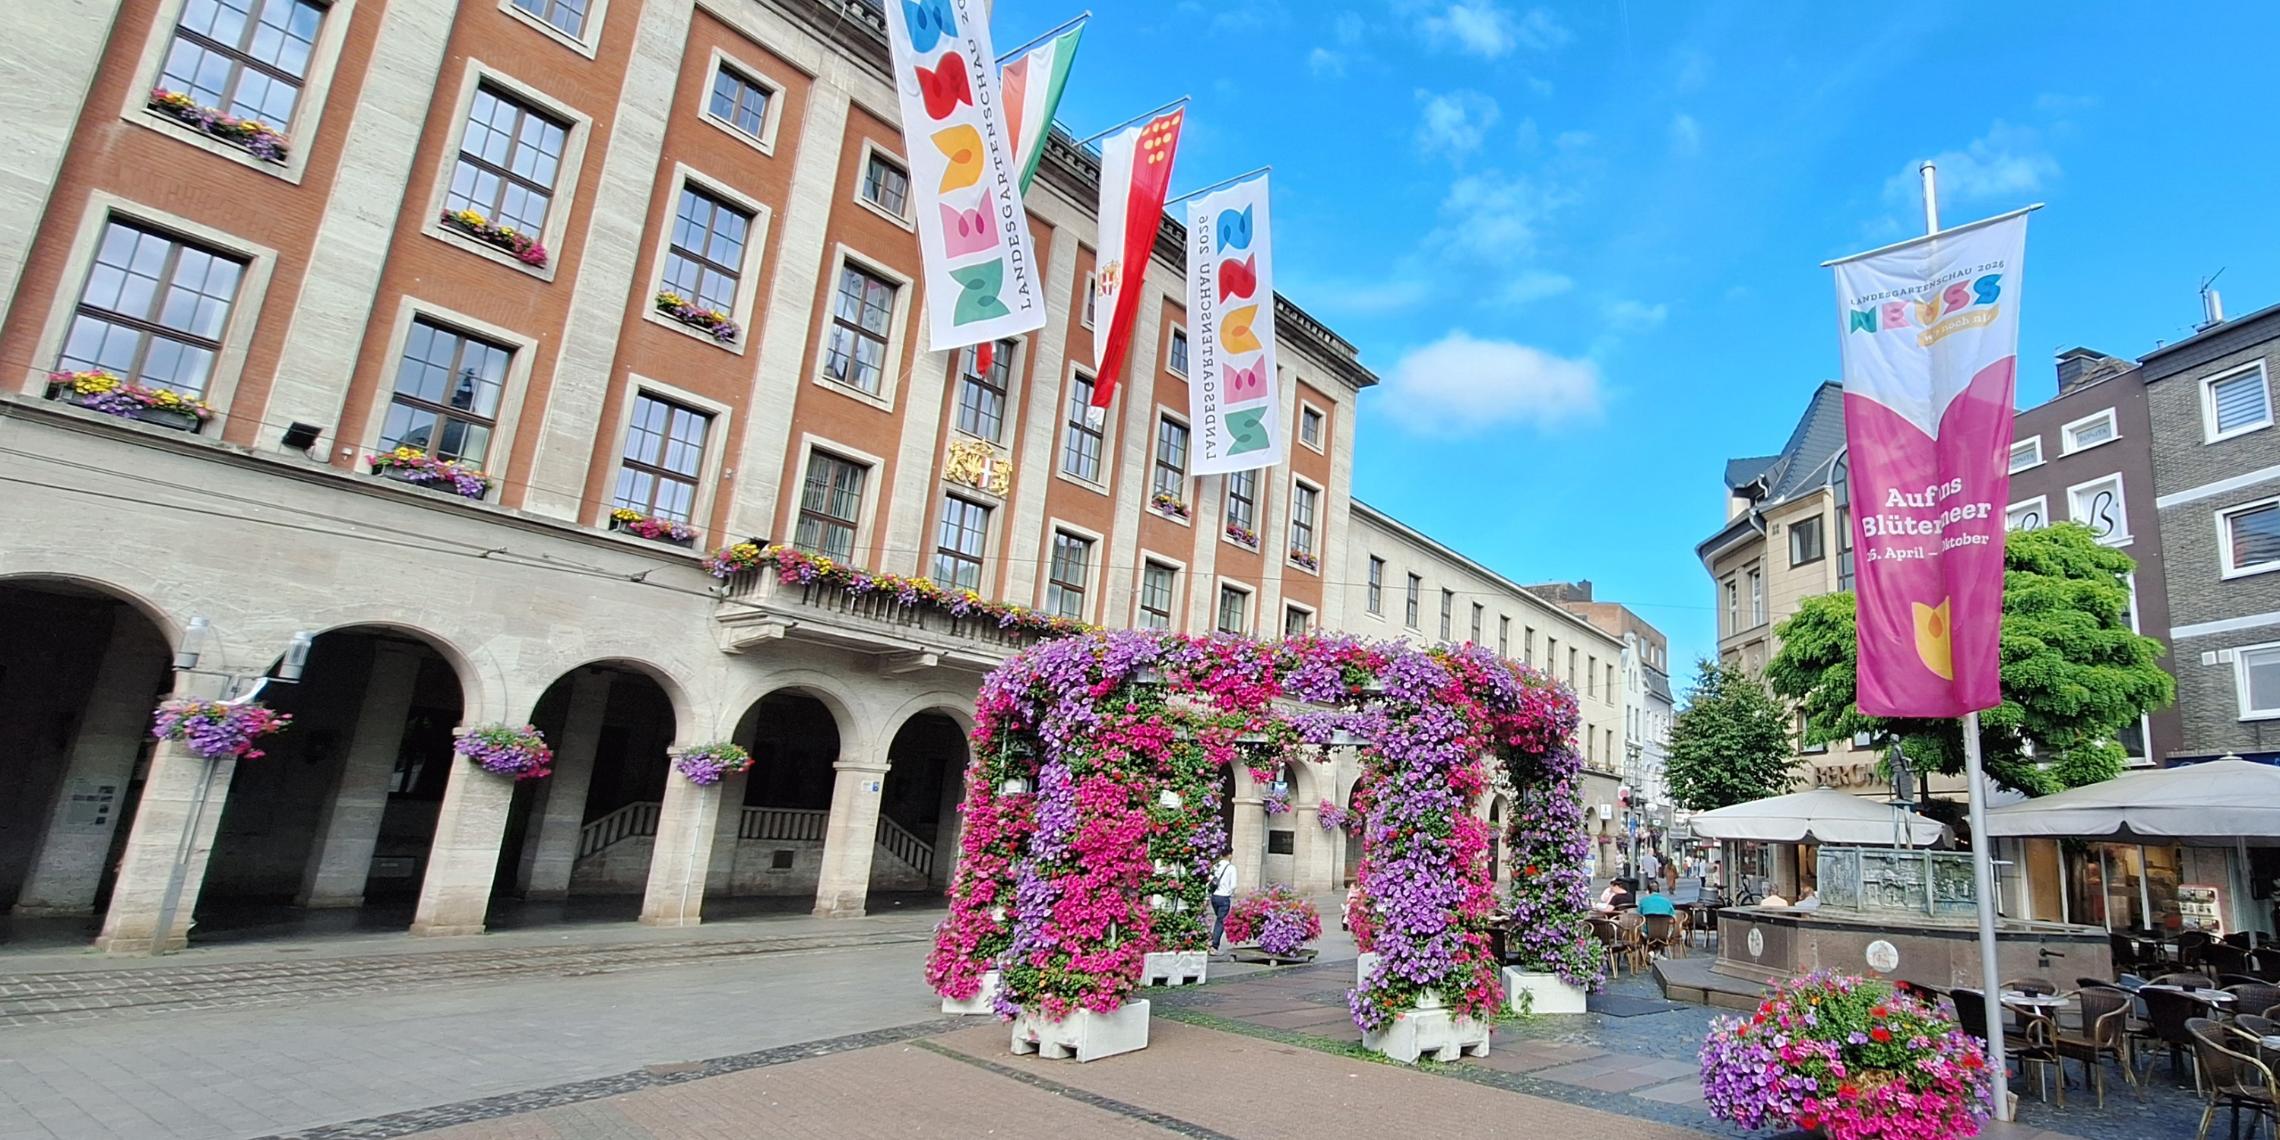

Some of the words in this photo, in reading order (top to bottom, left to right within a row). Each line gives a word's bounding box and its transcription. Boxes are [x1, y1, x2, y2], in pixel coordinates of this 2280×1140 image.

[958, 0, 969, 25] 20
[901, 0, 1011, 327] NEUSS
[968, 39, 1031, 310] LANDESGARTENSCHAU
[1977, 260, 2004, 272] 2026
[1850, 273, 2003, 335] NEUSS
[1885, 485, 1938, 508] Auf
[1884, 546, 1924, 561] April
[1942, 532, 1990, 552] ktober
